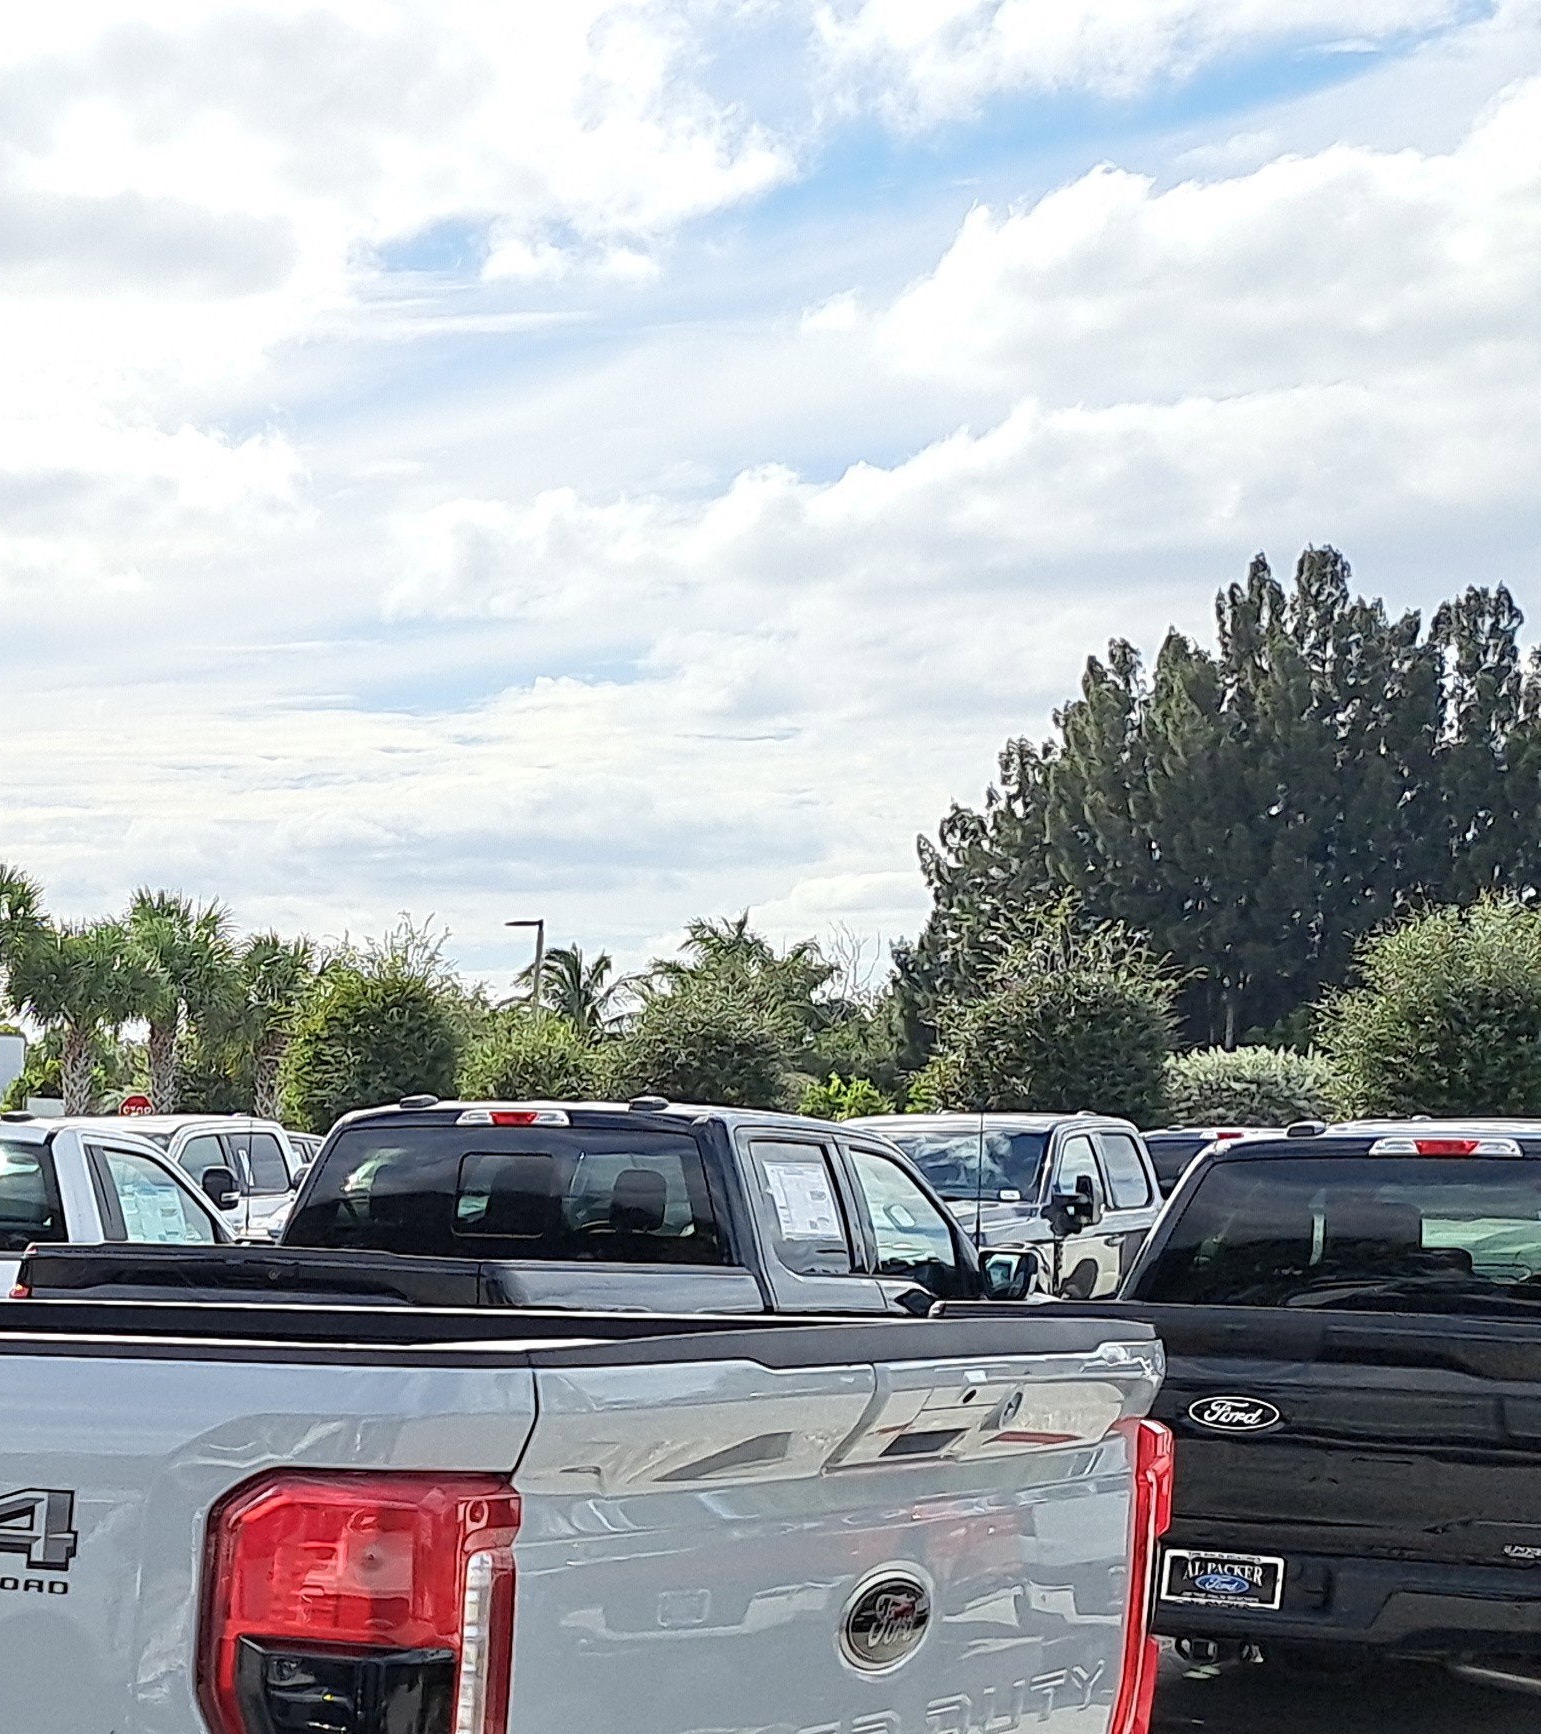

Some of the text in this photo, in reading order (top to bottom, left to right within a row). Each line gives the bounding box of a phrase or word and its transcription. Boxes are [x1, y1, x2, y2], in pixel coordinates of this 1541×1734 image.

[1204, 1400, 1263, 1425] Ford
[1182, 1561, 1264, 1587] AL PACKER
[868, 1593, 917, 1648] Ford
